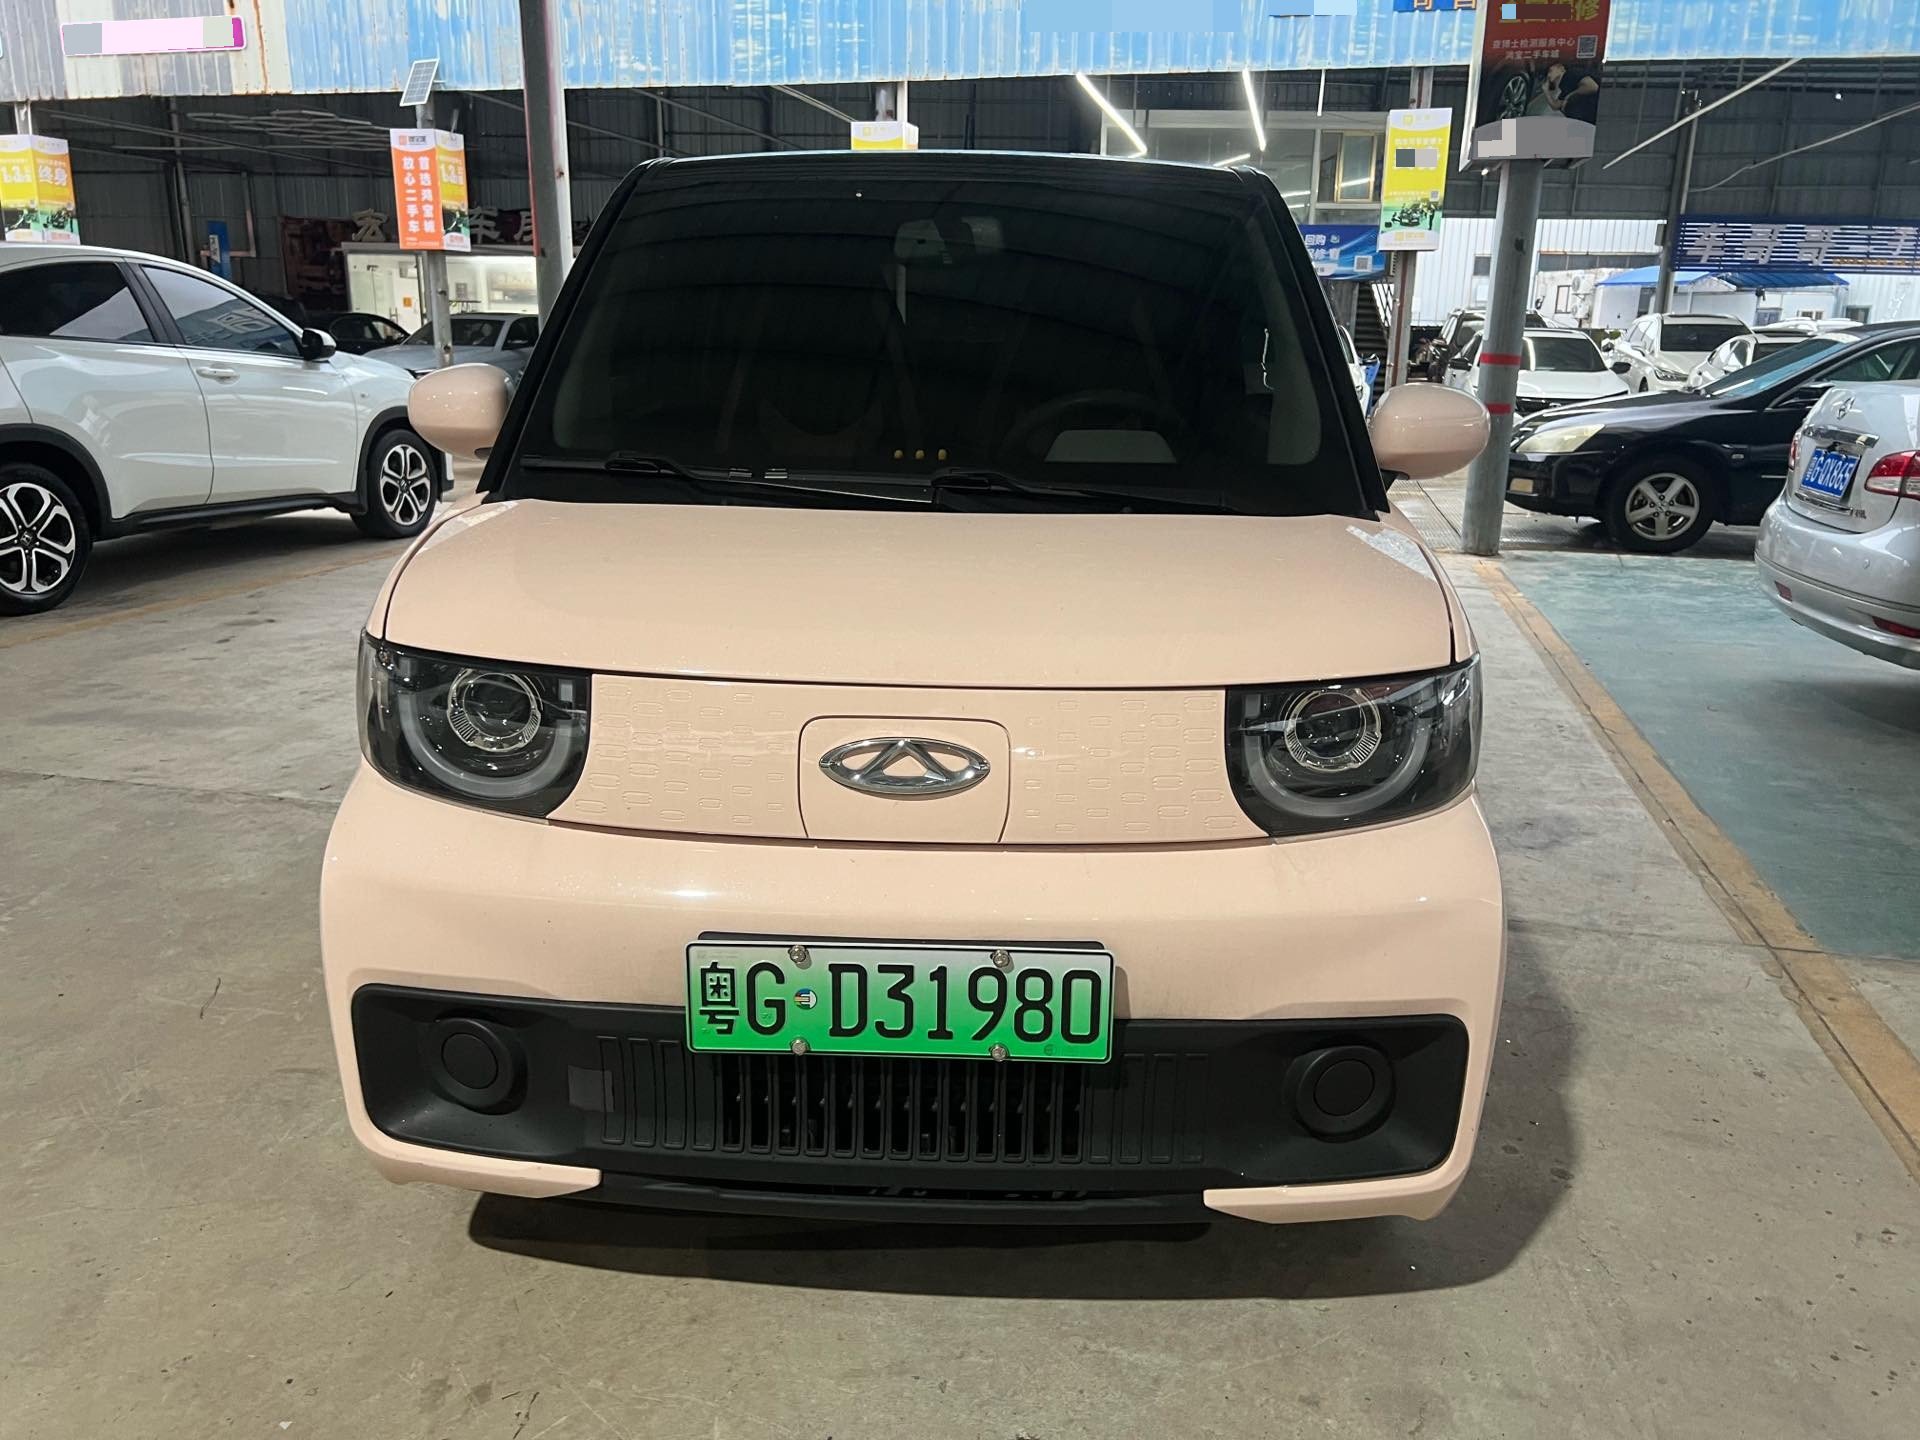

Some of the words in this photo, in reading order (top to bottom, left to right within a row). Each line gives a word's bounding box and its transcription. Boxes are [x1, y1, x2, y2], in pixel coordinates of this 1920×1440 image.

[402, 155, 420, 234] 放心二手车
